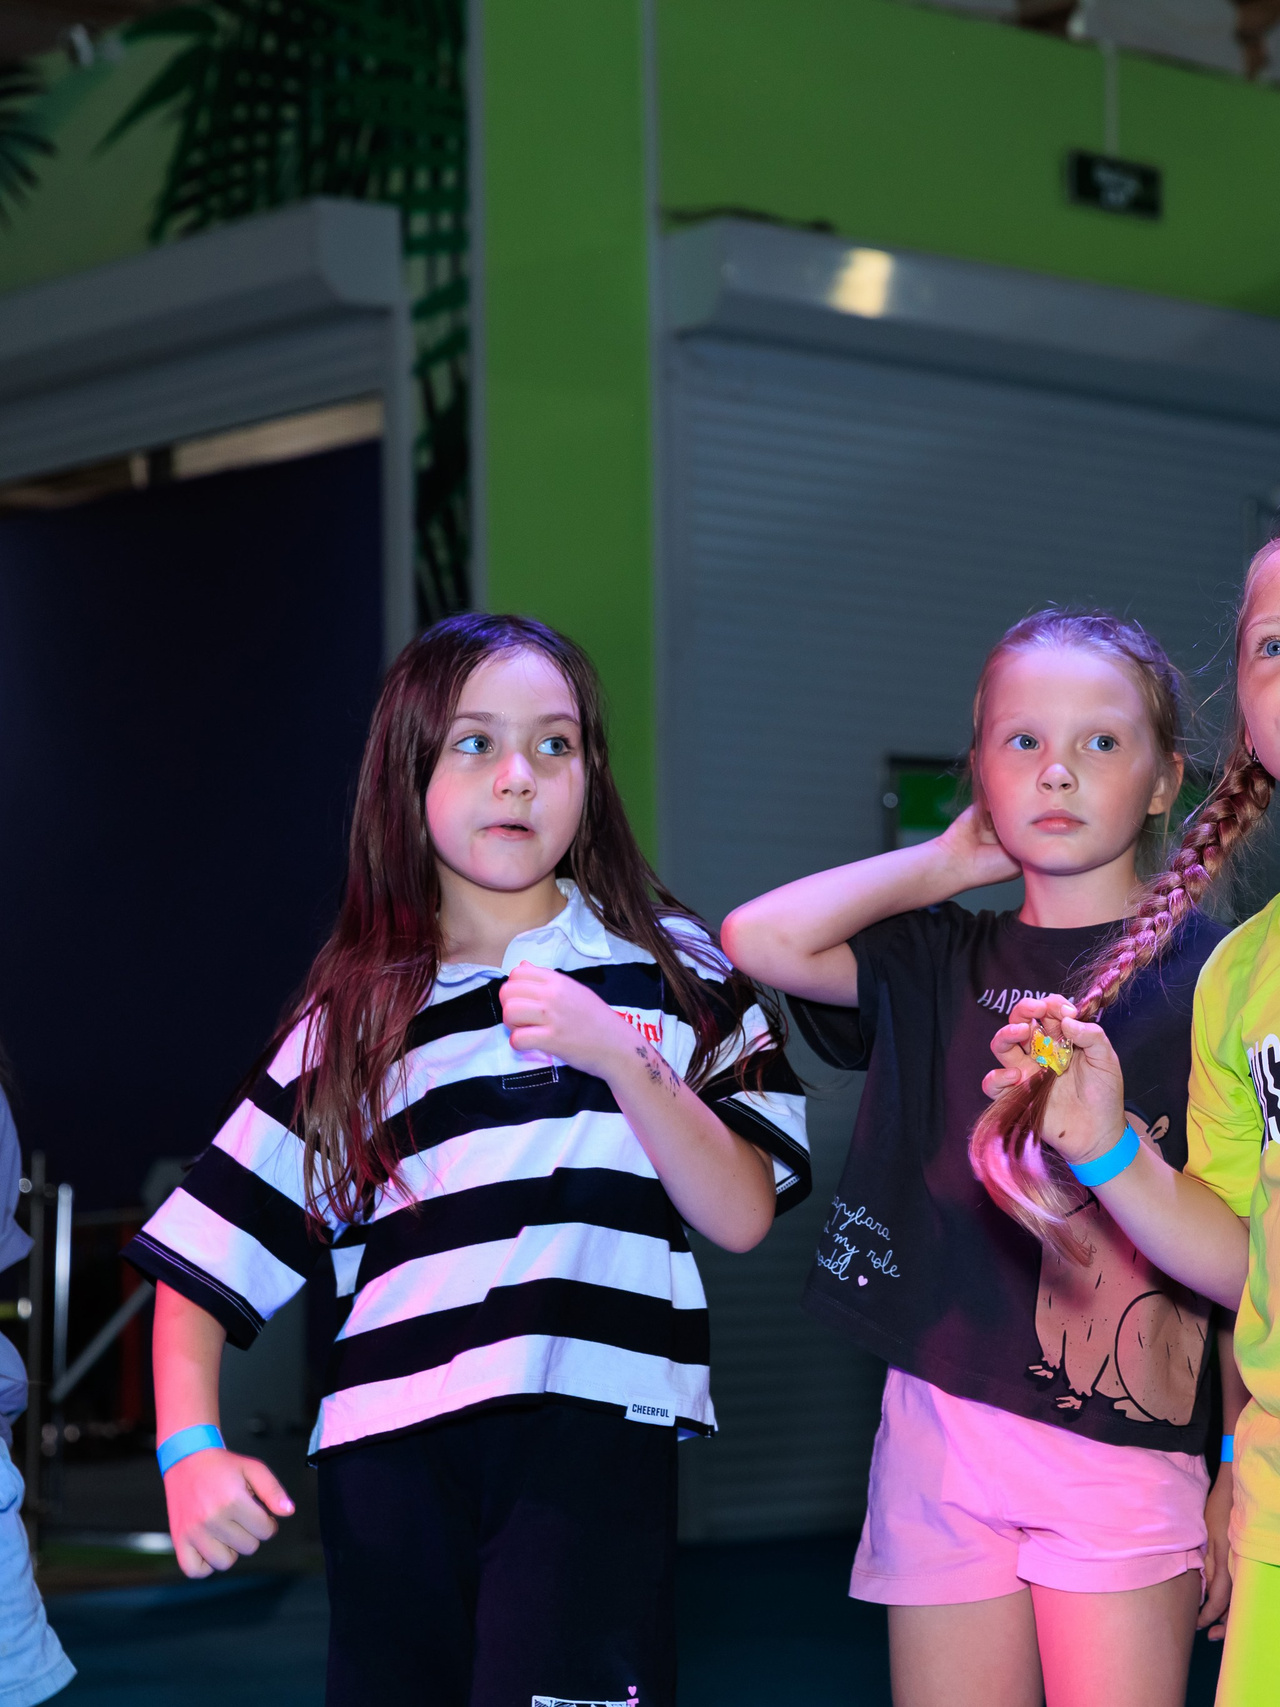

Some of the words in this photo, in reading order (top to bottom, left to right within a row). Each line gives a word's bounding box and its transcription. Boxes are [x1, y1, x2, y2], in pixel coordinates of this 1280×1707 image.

[832, 1195, 891, 1241] apybara
[833, 1233, 860, 1264] my
[866, 1250, 901, 1278] role
[631, 1403, 670, 1418] CHEERFUL
